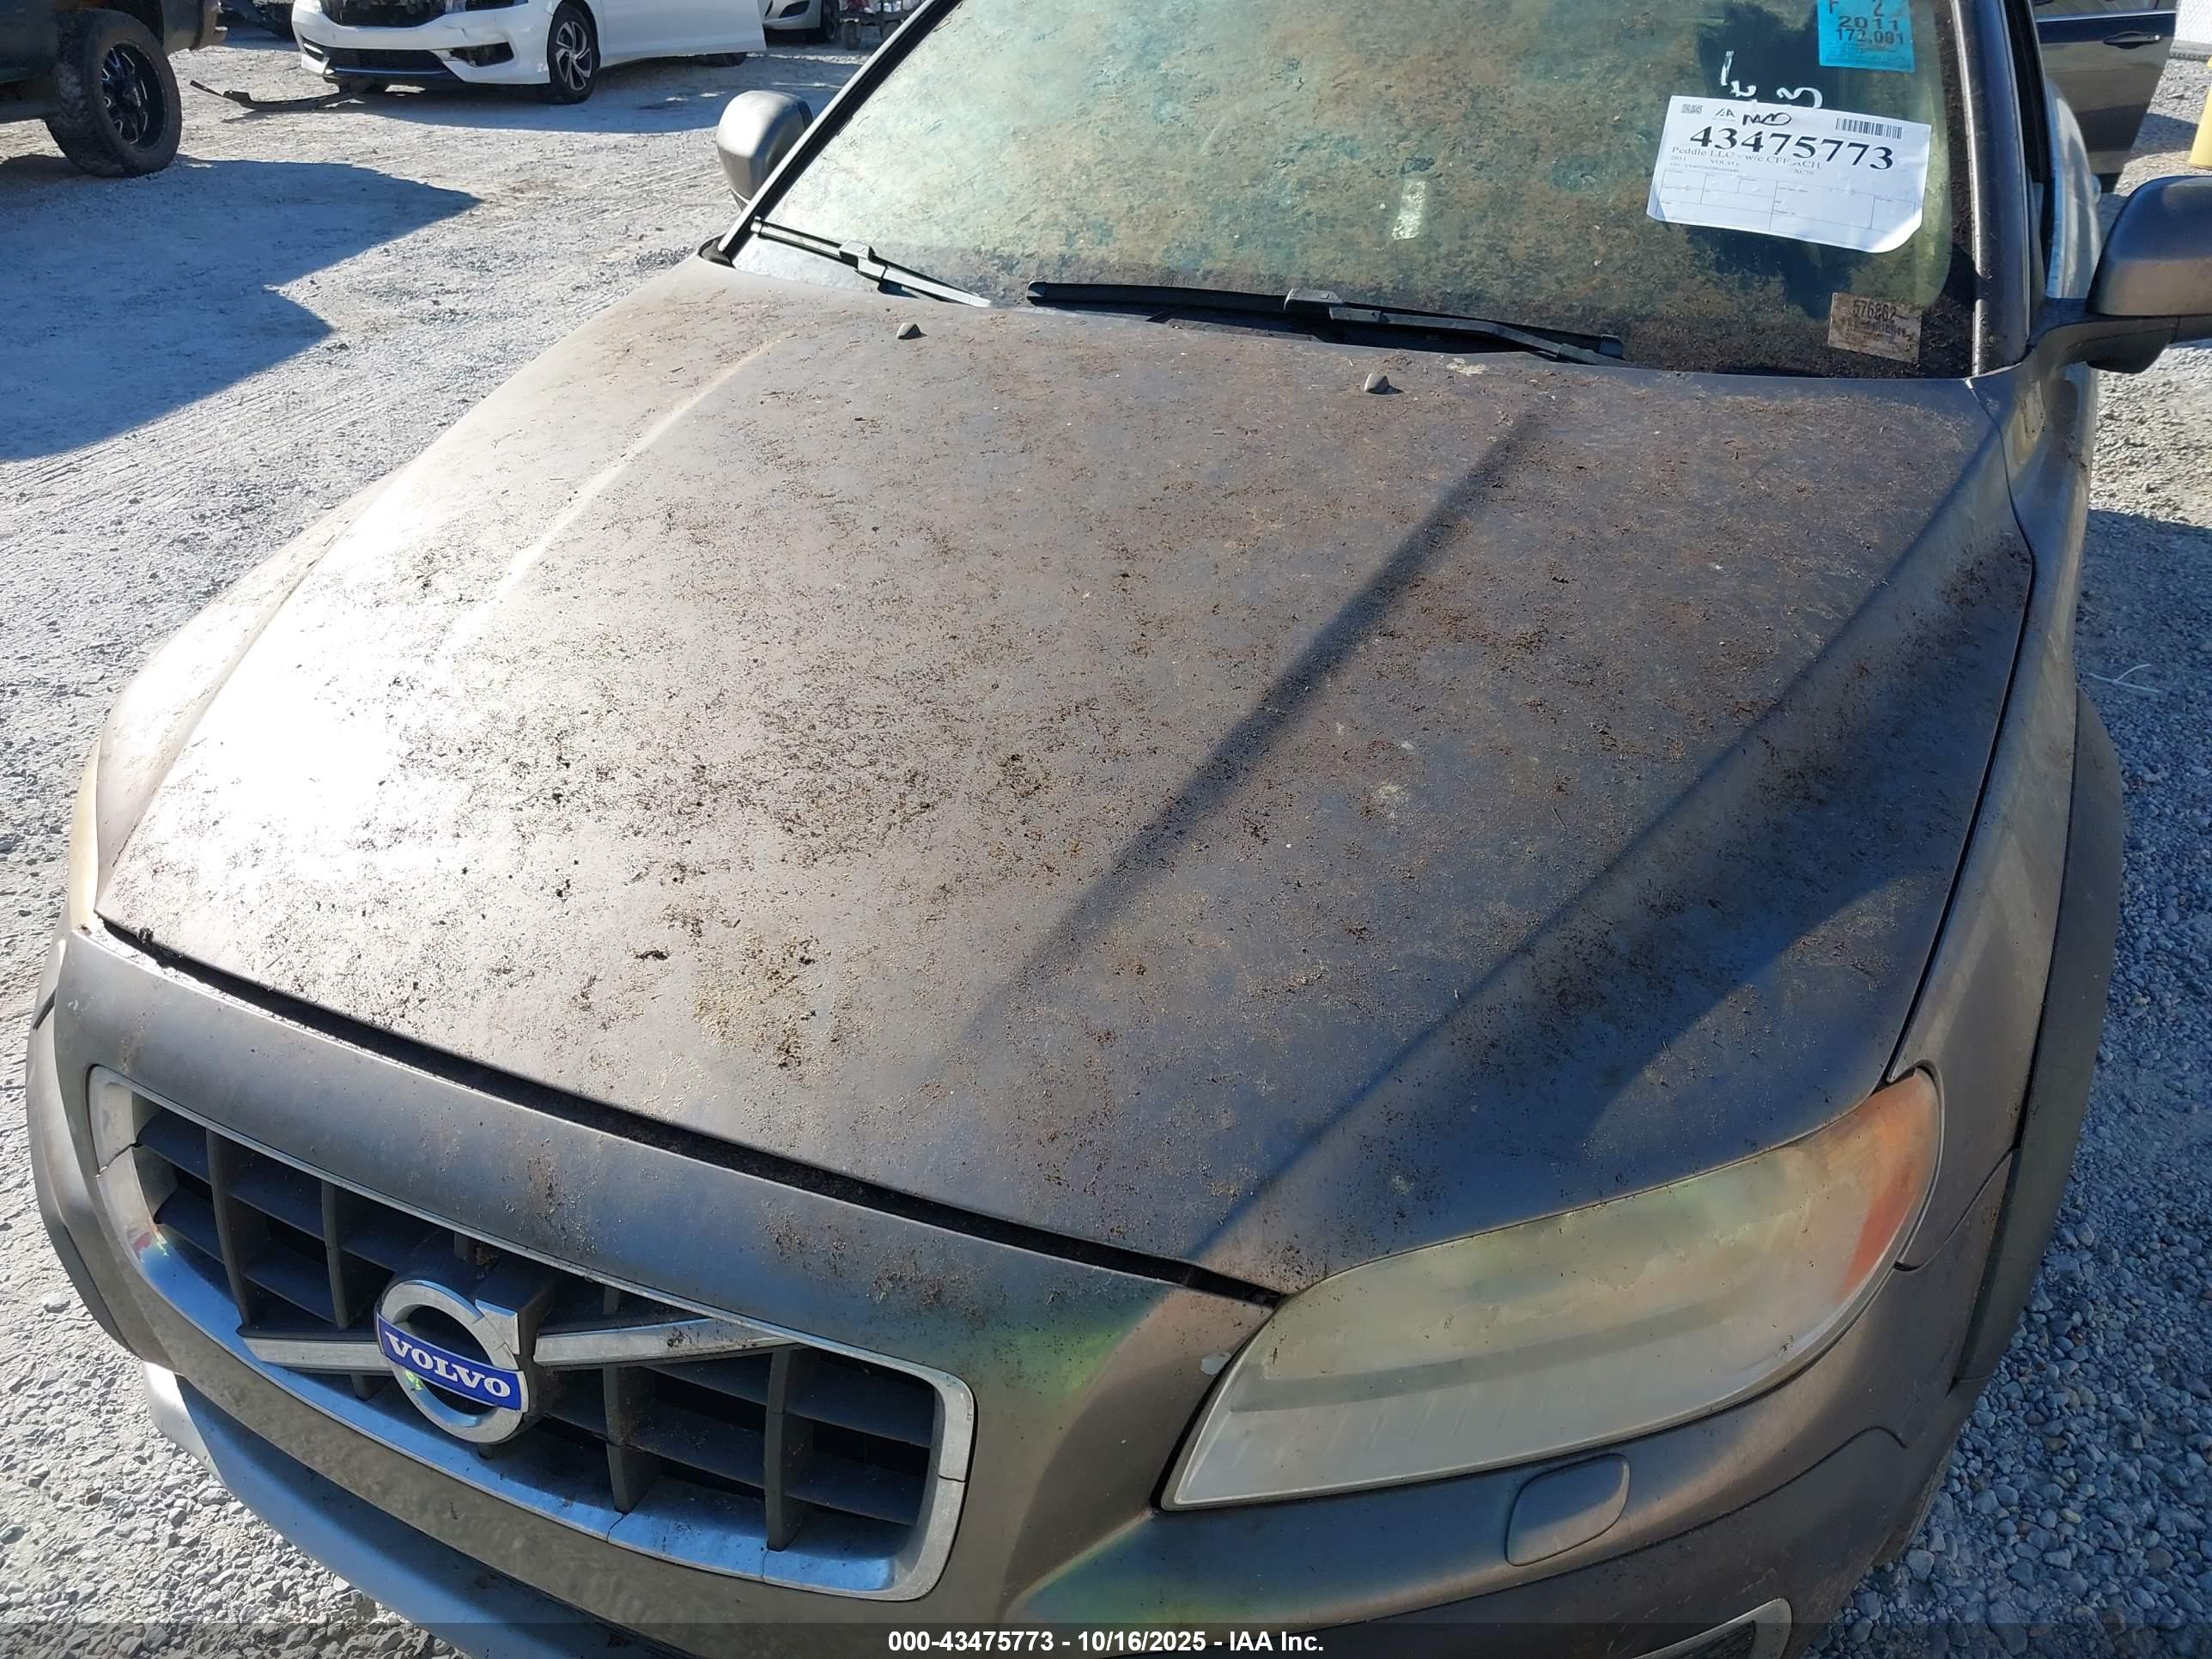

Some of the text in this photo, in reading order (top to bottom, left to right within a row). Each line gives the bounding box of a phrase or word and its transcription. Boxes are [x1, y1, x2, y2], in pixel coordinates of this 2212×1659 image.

[1838, 15, 1899, 32] 2011
[1671, 145, 1707, 156] Peddle
[1689, 125, 1894, 171] 43475773
[385, 1330, 512, 1398] VOLVO
